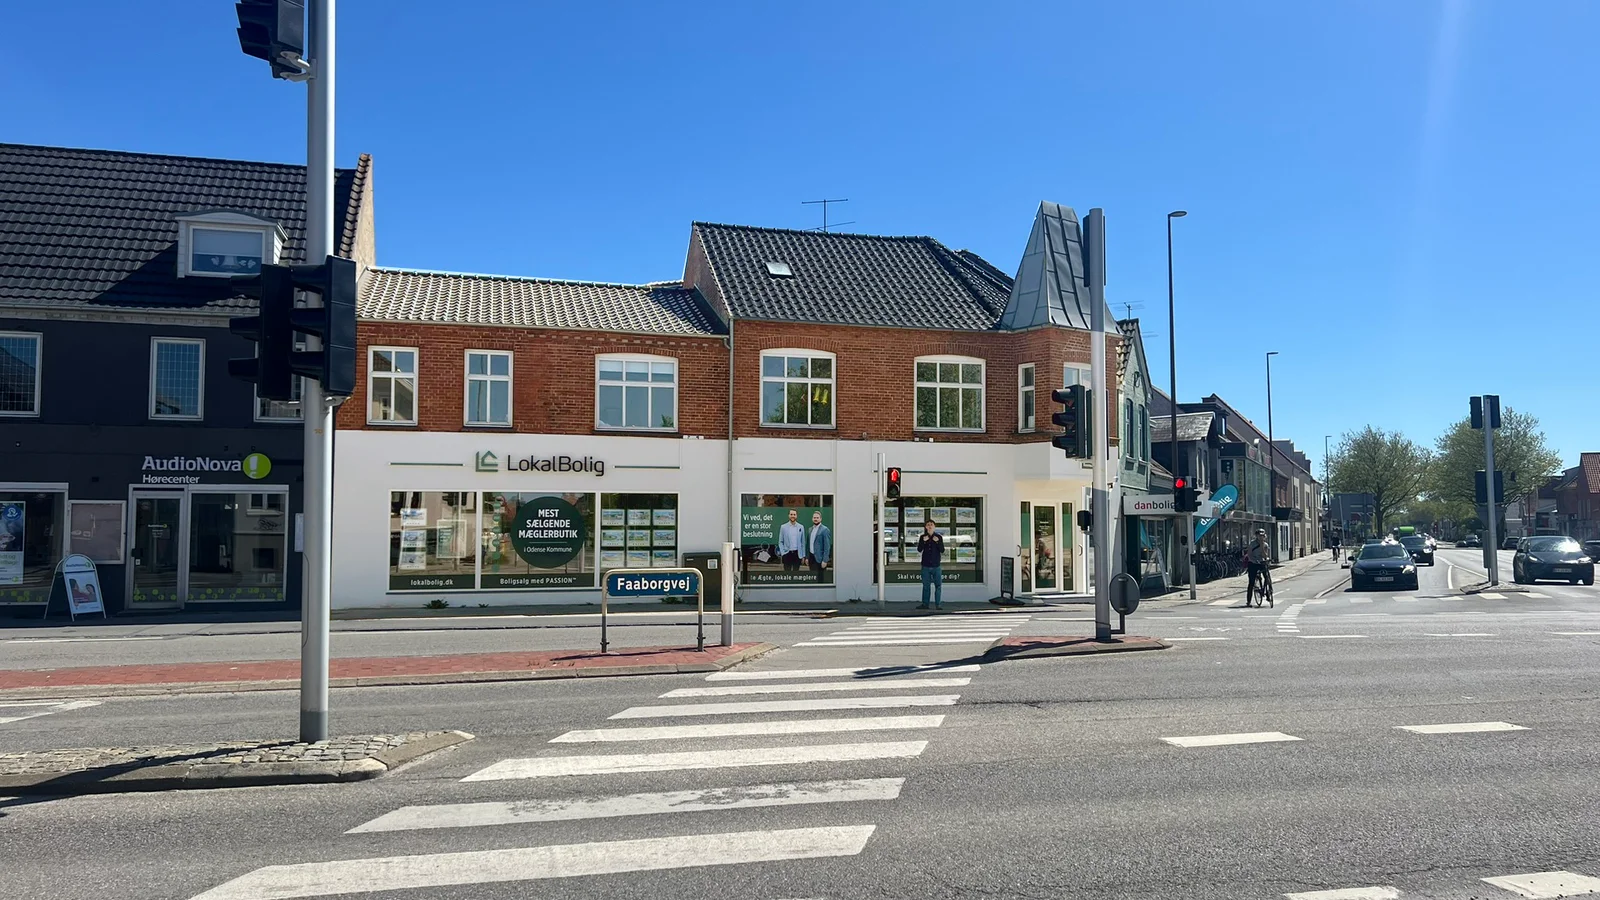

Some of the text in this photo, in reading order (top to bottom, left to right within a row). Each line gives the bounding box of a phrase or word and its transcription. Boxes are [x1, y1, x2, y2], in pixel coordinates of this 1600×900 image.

[142, 456, 242, 471] AudioNova
[507, 455, 605, 476] LokalBolig
[142, 474, 200, 483] Hørecenter
[538, 509, 560, 518] MEST
[750, 514, 762, 522] ved,
[526, 520, 571, 528] SÆLGENDE
[518, 530, 578, 539] MÆGLERBUTIK
[617, 577, 690, 592] Faaborgvej
